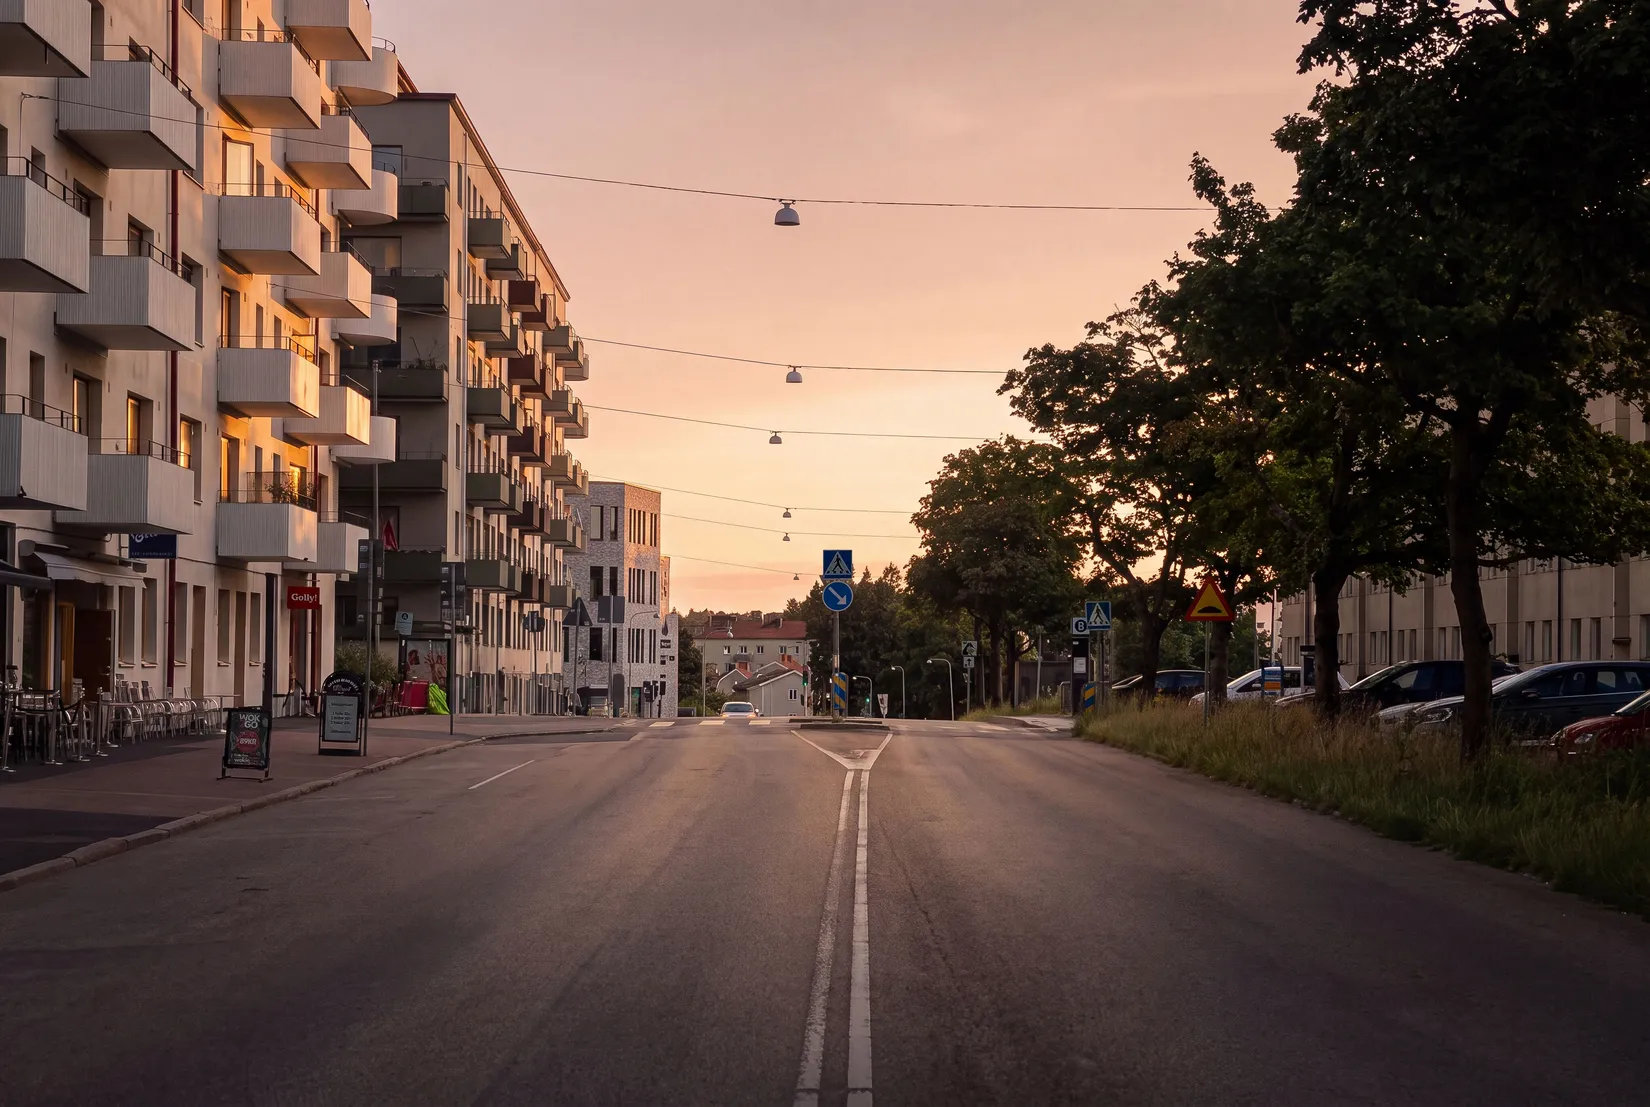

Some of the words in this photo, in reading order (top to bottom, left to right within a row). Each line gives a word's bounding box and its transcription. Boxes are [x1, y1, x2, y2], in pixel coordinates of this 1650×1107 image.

[291, 593, 317, 603] Golly!
[1078, 621, 1085, 631] B
[239, 713, 260, 722] WOK
